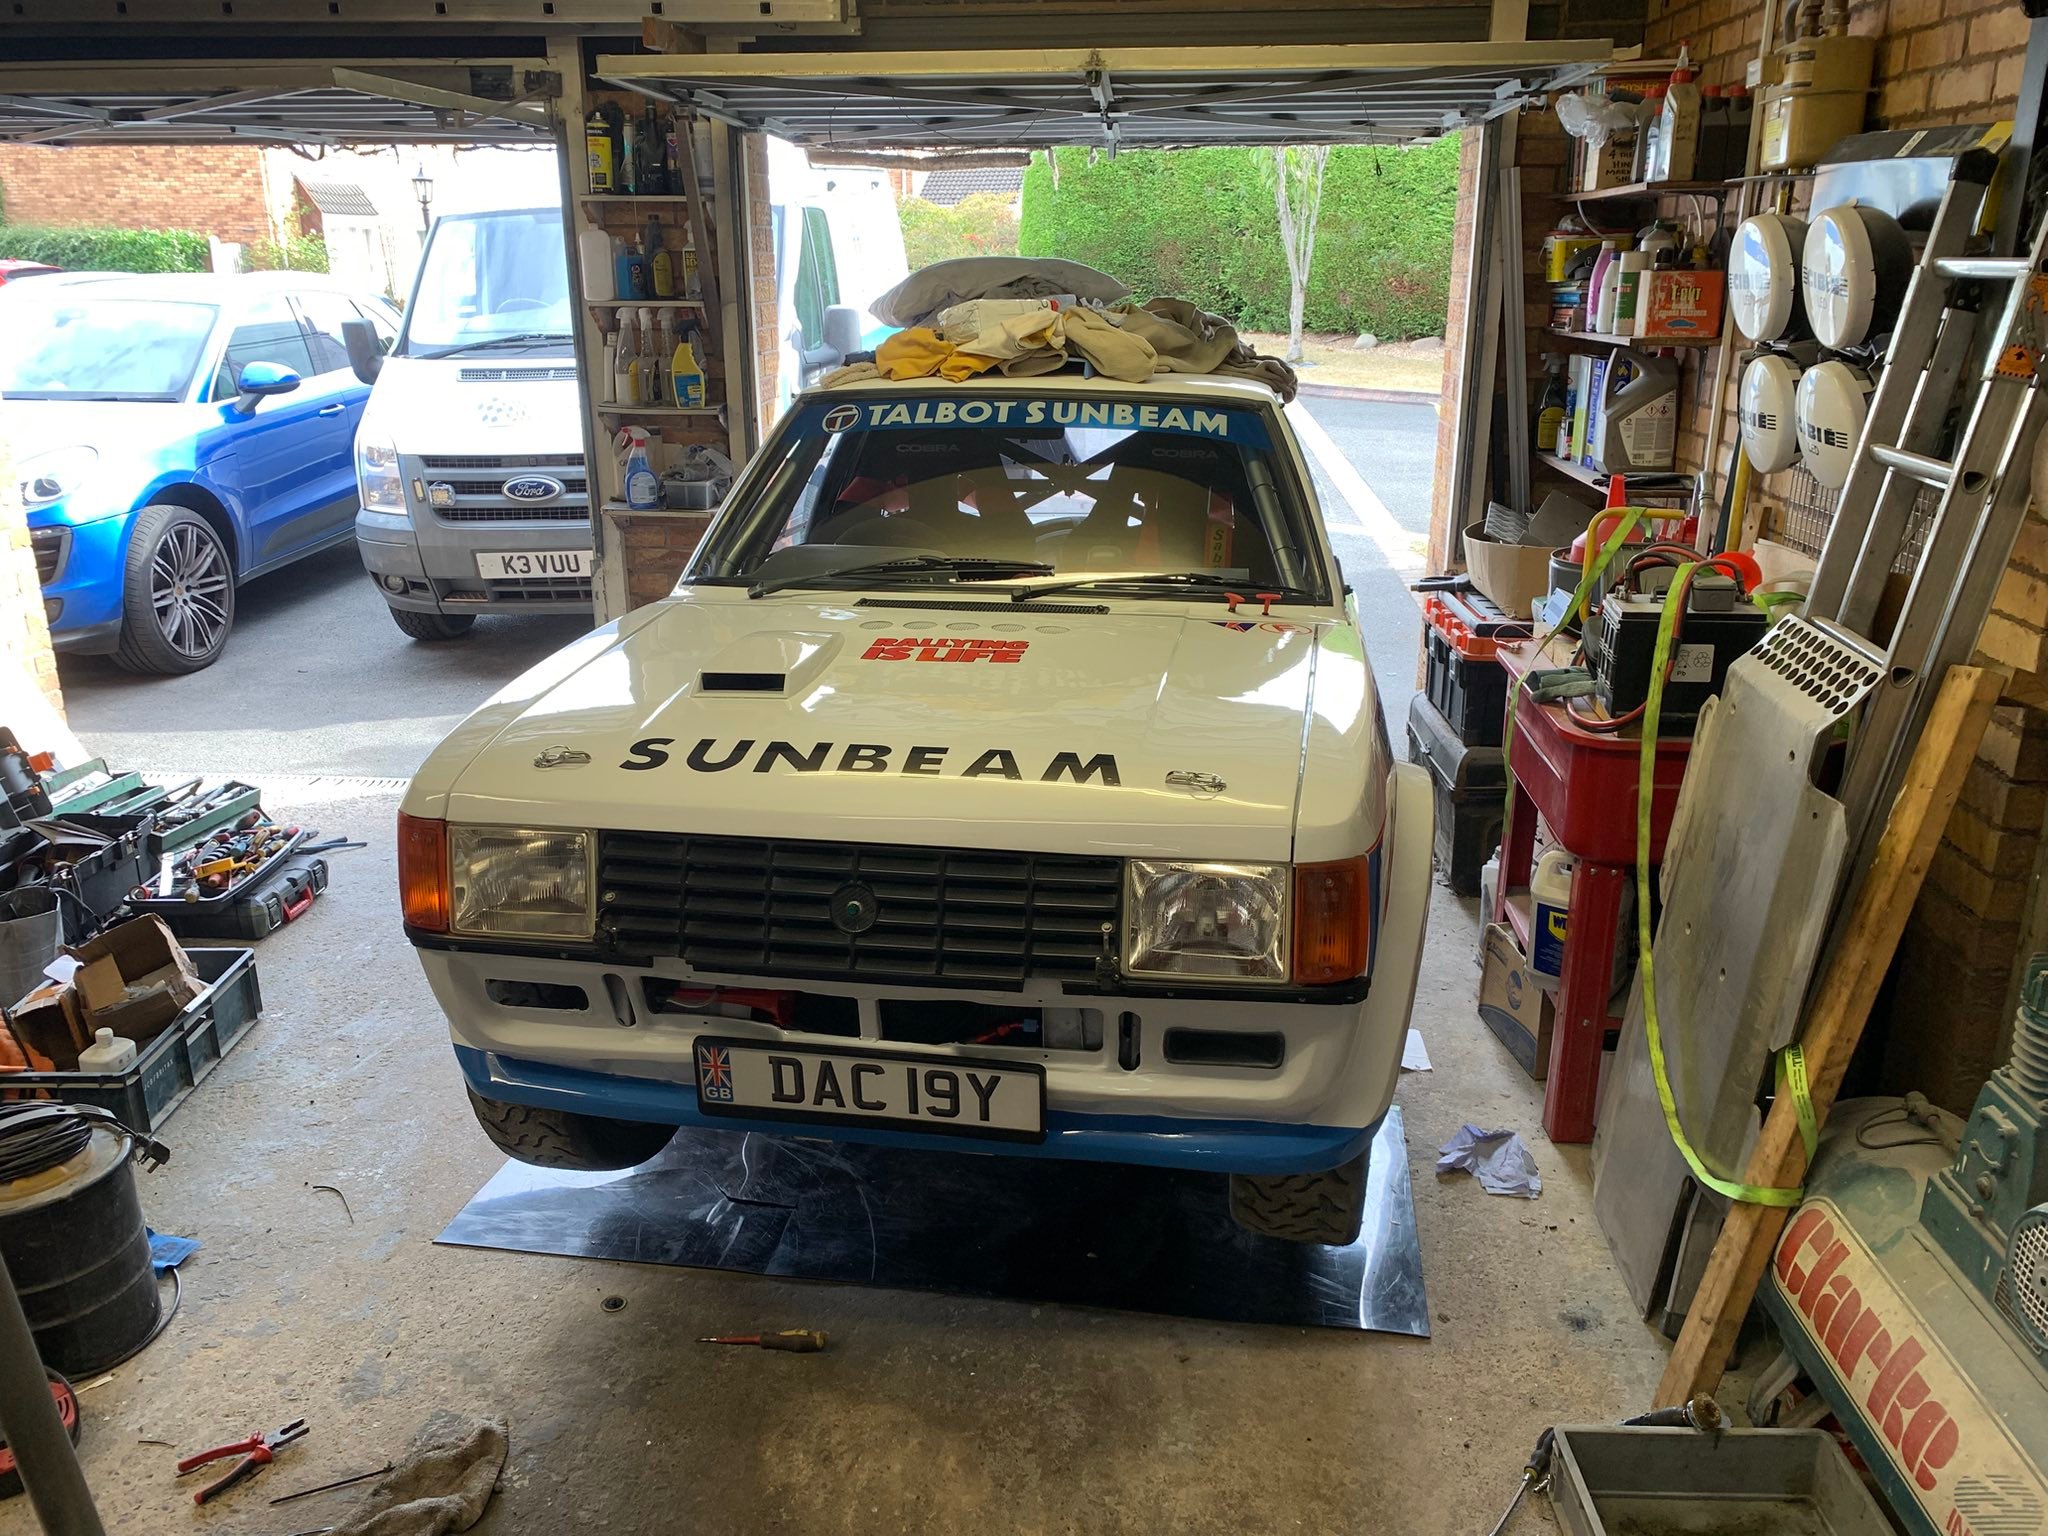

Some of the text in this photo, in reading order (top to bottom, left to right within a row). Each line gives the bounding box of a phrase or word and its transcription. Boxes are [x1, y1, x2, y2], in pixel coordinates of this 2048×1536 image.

[868, 400, 1018, 428] TALBOT
[1024, 401, 1230, 437] SUNBEAM
[1151, 447, 1219, 460] COBRA
[515, 481, 545, 496] Ford
[501, 554, 581, 575] K3 VUU
[871, 638, 1030, 649] RALLYING
[860, 647, 1026, 663] IS LIFE
[619, 738, 1123, 787] SUNBEAM
[705, 1086, 732, 1100] GB
[768, 1055, 1001, 1122] DAC 19Y
[1776, 1207, 1961, 1492] Clarke
